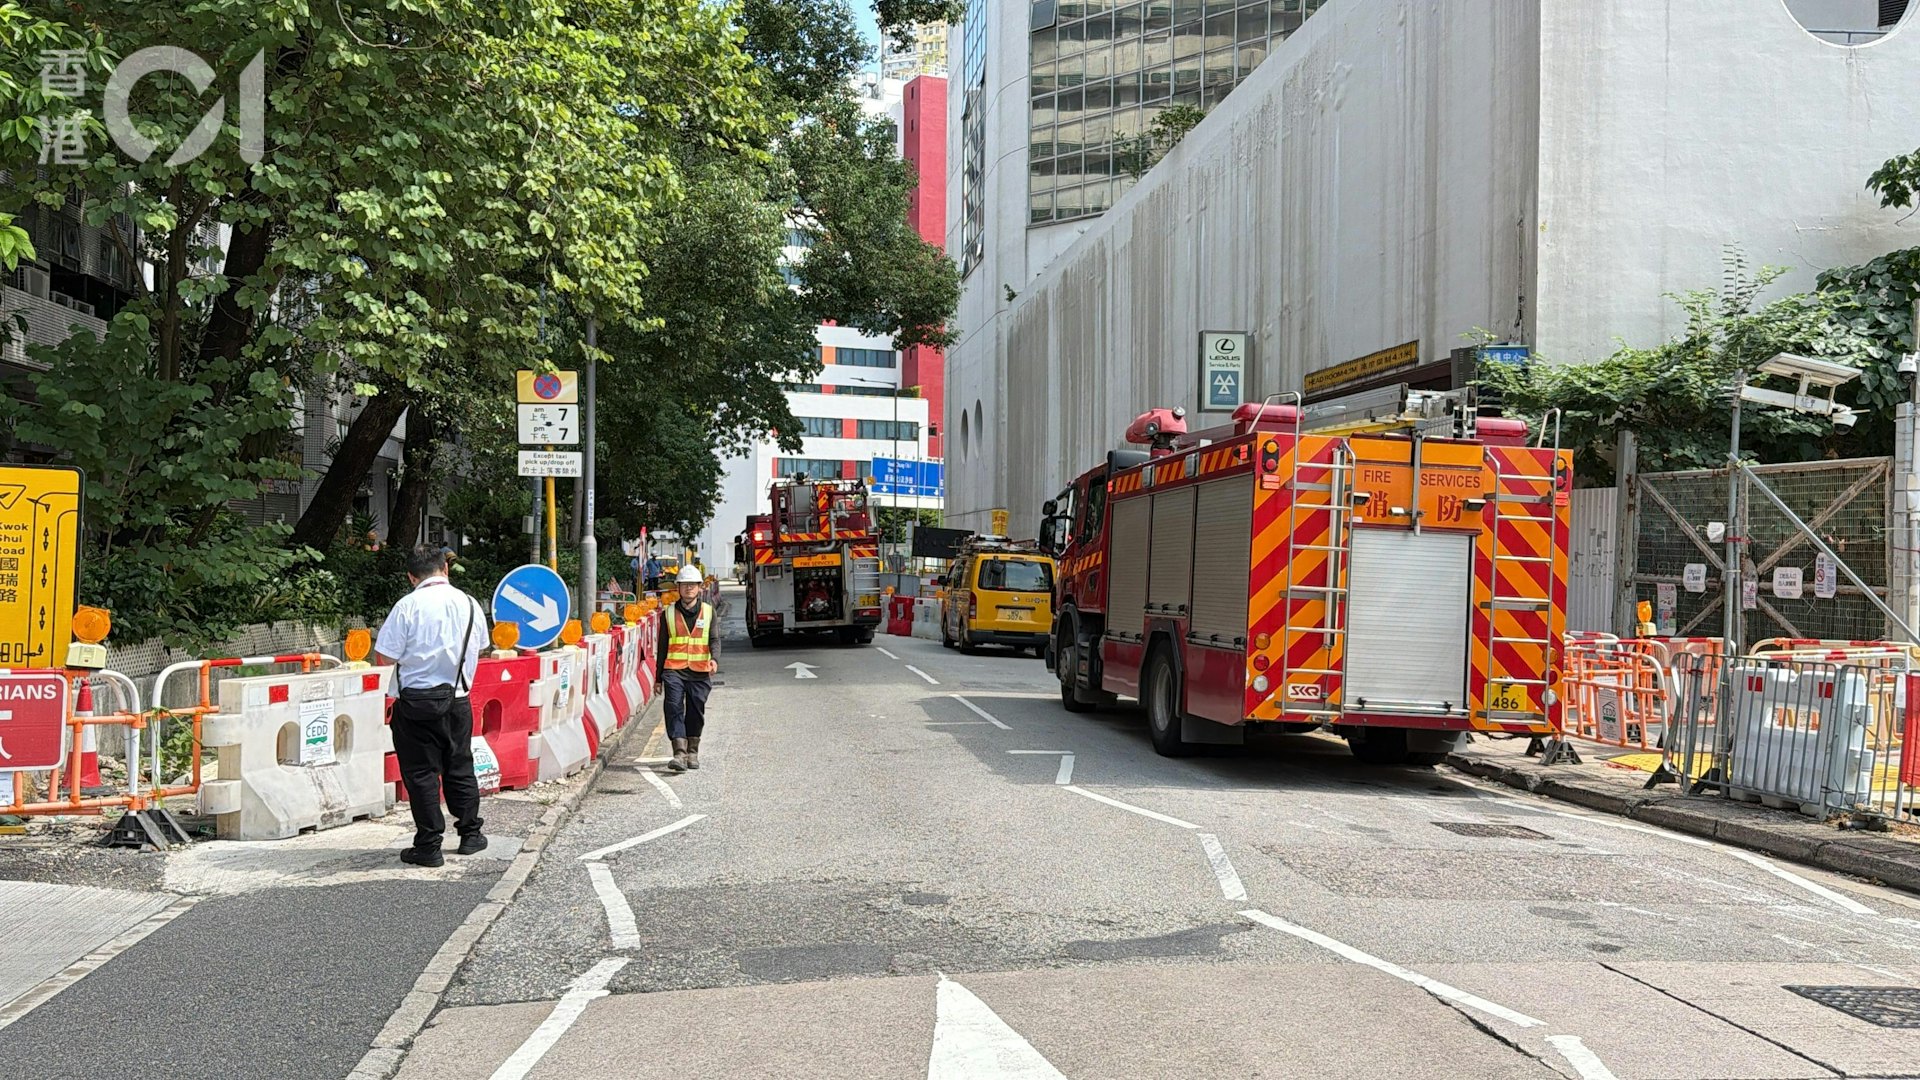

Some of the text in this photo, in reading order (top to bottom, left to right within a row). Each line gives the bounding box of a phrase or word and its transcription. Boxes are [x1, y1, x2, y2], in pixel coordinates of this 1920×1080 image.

[530, 412, 549, 421] 上午
[558, 408, 568, 421] 7
[530, 433, 549, 441] 下午
[558, 428, 568, 440] 7
[522, 466, 577, 475] 的士上落客除外
[1363, 469, 1481, 488] FIRE SERVICES
[0, 547, 25, 555] oad
[1501, 686, 1510, 697] F
[1492, 698, 1519, 709] 486
[306, 724, 328, 738] CEDD
[474, 754, 492, 765] EDD
